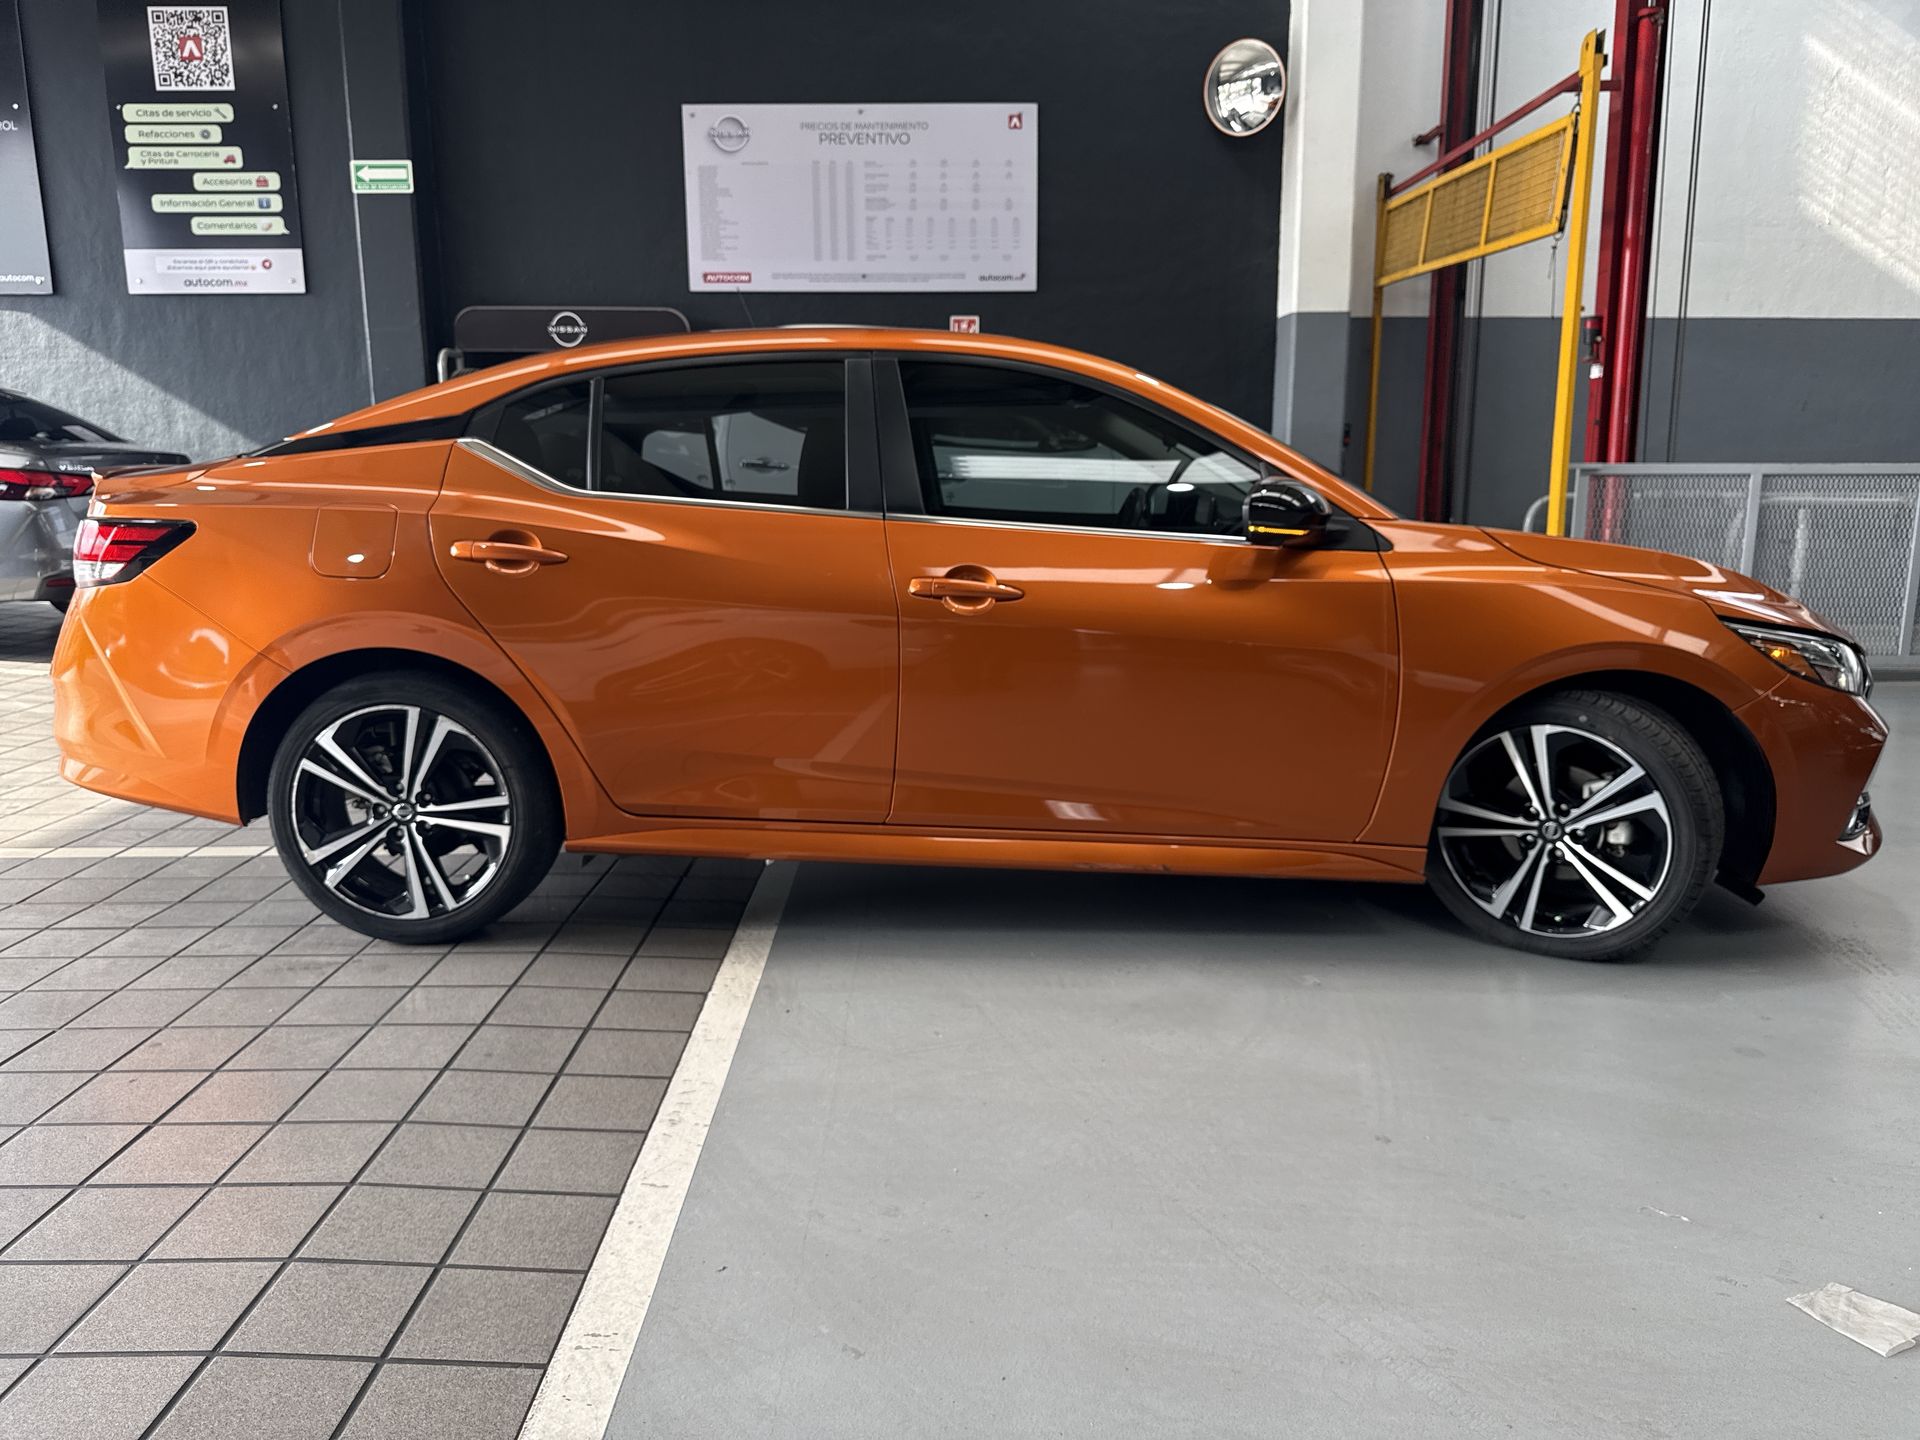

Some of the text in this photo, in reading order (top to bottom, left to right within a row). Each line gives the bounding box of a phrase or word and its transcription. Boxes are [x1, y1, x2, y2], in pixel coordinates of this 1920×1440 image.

[136, 108, 212, 118] Citas de servicio
[800, 121, 838, 131] PRECIOS
[841, 121, 852, 131] DE
[138, 129, 195, 139] Refacciones
[818, 132, 911, 146] PREVENTIVO
[140, 150, 161, 158] Citas
[163, 150, 174, 158] de
[148, 158, 179, 166] Pintura
[202, 176, 253, 186] Accesorios
[219, 198, 255, 208] General
[197, 220, 258, 230] Comentarios
[547, 325, 588, 334] NISSAN
